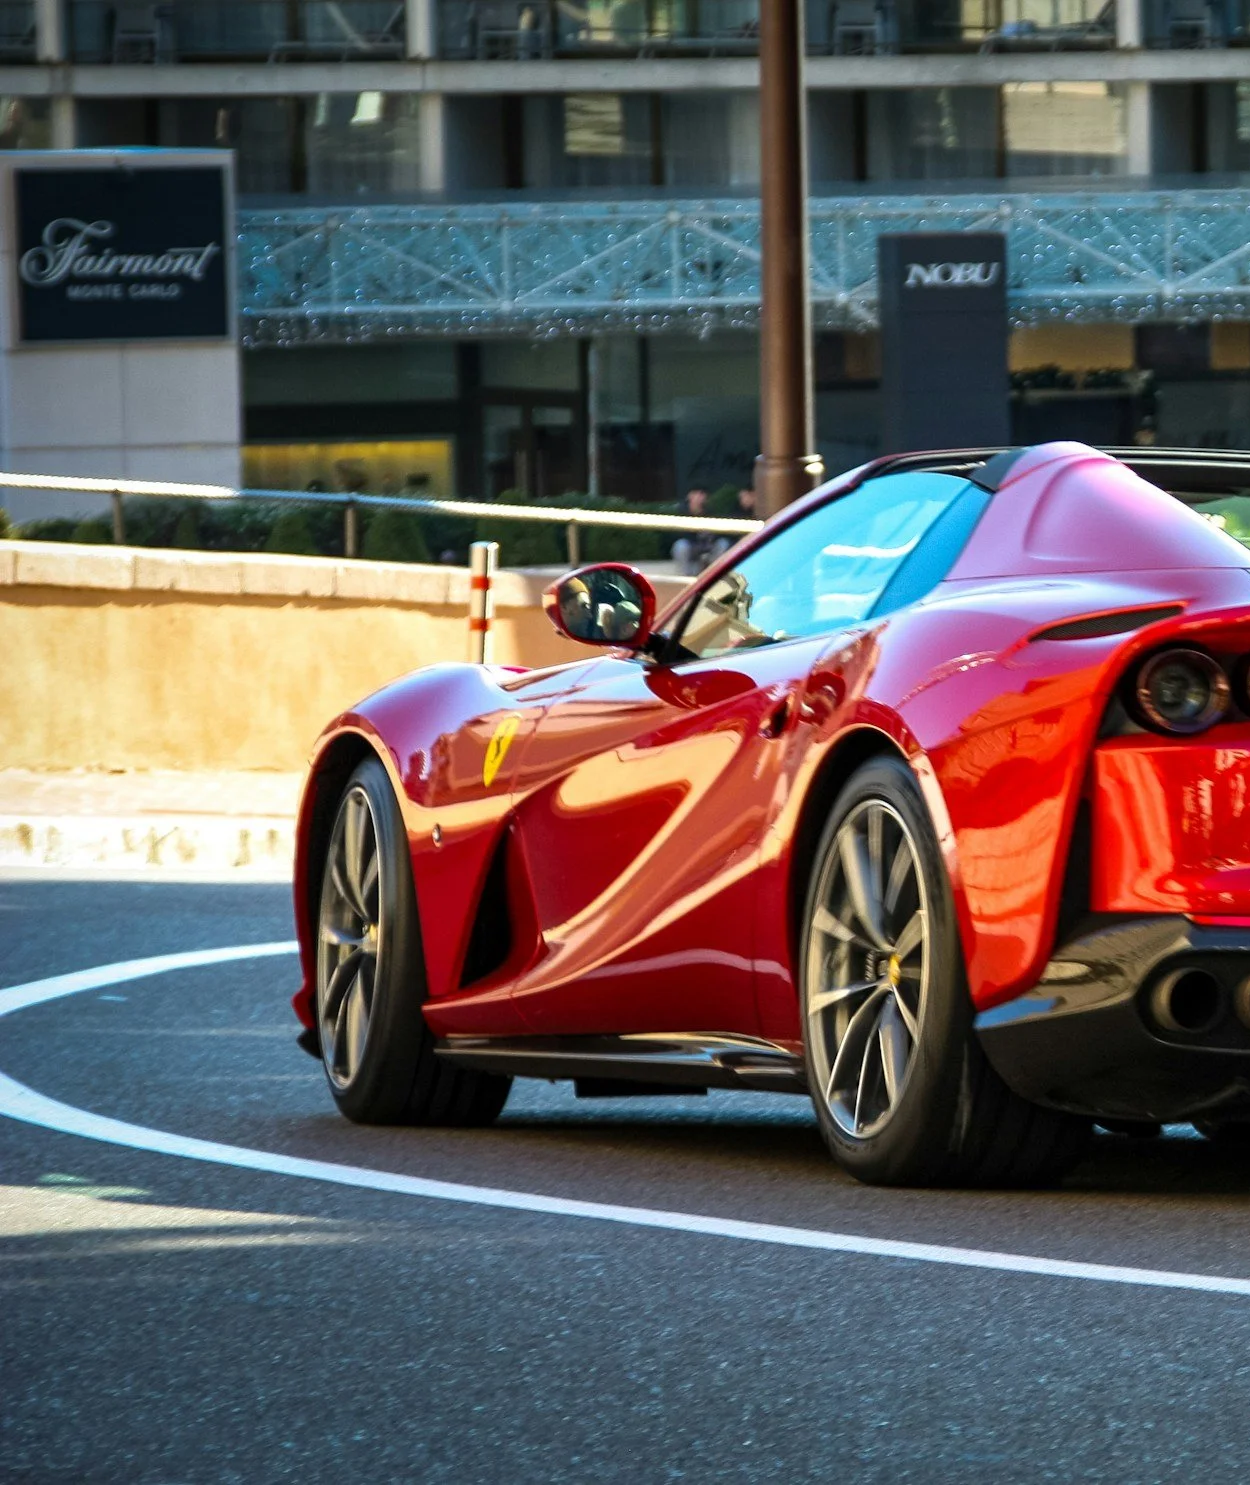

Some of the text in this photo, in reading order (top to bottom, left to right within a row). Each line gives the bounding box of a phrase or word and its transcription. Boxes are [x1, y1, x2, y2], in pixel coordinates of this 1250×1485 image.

[20, 217, 220, 286] Fairmont
[904, 262, 1000, 287] NOBU
[67, 283, 183, 299] MONTE CARLO
